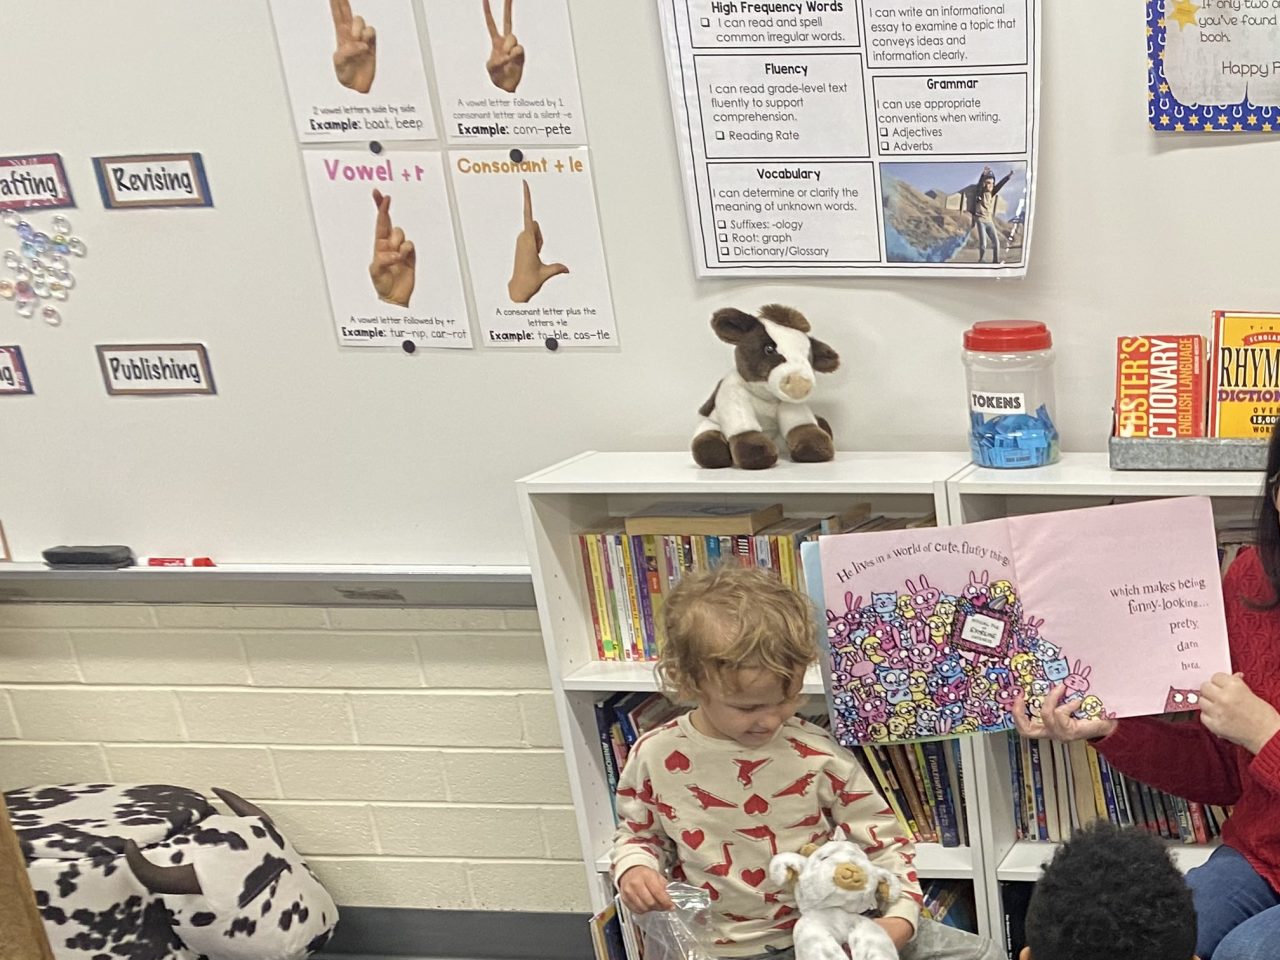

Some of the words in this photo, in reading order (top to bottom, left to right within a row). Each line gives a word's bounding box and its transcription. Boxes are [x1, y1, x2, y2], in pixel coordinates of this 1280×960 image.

[712, 1, 738, 15] High
[741, 1, 802, 15] Frequency
[806, 1, 843, 12] Words
[869, 8, 872, 17] I
[875, 9, 896, 18] can
[899, 7, 923, 17] write
[926, 8, 938, 16] an
[941, 4, 1005, 16] informational
[718, 19, 721, 27] I
[724, 19, 745, 27] can
[749, 18, 773, 27] read
[776, 18, 797, 27] and
[800, 17, 823, 28] spell
[871, 23, 899, 33] essay
[902, 22, 912, 31] to
[915, 21, 958, 31] examine
[960, 22, 967, 30] a
[970, 19, 994, 32] topic
[997, 18, 1016, 28] that
[1199, 15, 1238, 28] you've
[1241, 14, 1277, 25] found
[716, 33, 765, 42] common
[767, 32, 809, 43] irregular
[812, 32, 845, 41] words.
[872, 38, 914, 48] conveys
[917, 35, 944, 46] ideas
[946, 35, 966, 45] and
[1200, 31, 1231, 42] book.
[873, 51, 930, 61] information
[933, 50, 968, 61] clearly.
[765, 64, 808, 76] Fluency
[1222, 61, 1269, 77] Happy
[709, 84, 712, 94] I
[715, 85, 736, 94] can
[739, 84, 765, 94] read
[768, 83, 826, 95] grade-level
[829, 83, 847, 92] text
[927, 78, 978, 89] Grammar
[711, 98, 749, 109] fluently
[752, 99, 763, 107] to
[766, 98, 804, 109] support
[877, 100, 880, 109] I
[883, 101, 902, 109] can
[905, 101, 922, 109] use
[924, 98, 981, 112] appropriate
[713, 112, 797, 122] comprehension.
[879, 113, 938, 123] conventions
[941, 112, 966, 122] when
[969, 112, 1001, 124] writing.
[310, 118, 361, 132] Example:
[364, 118, 394, 130] boat,
[395, 118, 423, 131] beep
[458, 123, 509, 137] Example:
[513, 123, 571, 138] com-pete
[729, 131, 773, 142] Reading
[776, 131, 799, 140] Rate
[892, 127, 942, 139] Adjectives
[894, 141, 932, 151] Adverbs
[324, 159, 394, 181] Vowel
[415, 165, 424, 180] r
[457, 157, 547, 173] Consonant
[569, 156, 583, 172] le
[111, 167, 194, 194] Revising
[757, 168, 820, 181] Vocabulary
[713, 189, 715, 198] I
[719, 189, 740, 198] can
[743, 188, 794, 198] determine
[798, 189, 807, 197] or
[810, 187, 839, 199] clarify
[842, 187, 858, 197] the
[715, 202, 762, 213] meaning
[765, 201, 775, 211] of
[777, 201, 822, 211] unknown
[825, 201, 857, 211] words.
[730, 220, 769, 229] Suffixes:
[772, 220, 803, 231] -ology
[732, 233, 759, 243] Root:
[762, 233, 792, 244] graph
[734, 247, 829, 257] Dictionary/Glossary
[341, 327, 386, 339] Example:
[390, 328, 428, 340] tur-nip,
[431, 329, 467, 339] car-rot
[490, 330, 534, 342] Example:
[538, 330, 571, 340] ta-ble,
[574, 330, 610, 339] cas-tle
[109, 356, 201, 383] Publishing
[1178, 338, 1192, 391] LANGUAGE
[972, 394, 1021, 409] TOKENS
[1178, 393, 1192, 434] ENGLISH
[836, 568, 853, 583] He
[852, 560, 875, 574] lives
[893, 543, 921, 558] world
[923, 542, 932, 553] of
[934, 542, 961, 553] cute,
[962, 541, 987, 558] fluffy
[1143, 581, 1176, 593] makes
[1178, 578, 1206, 590] being
